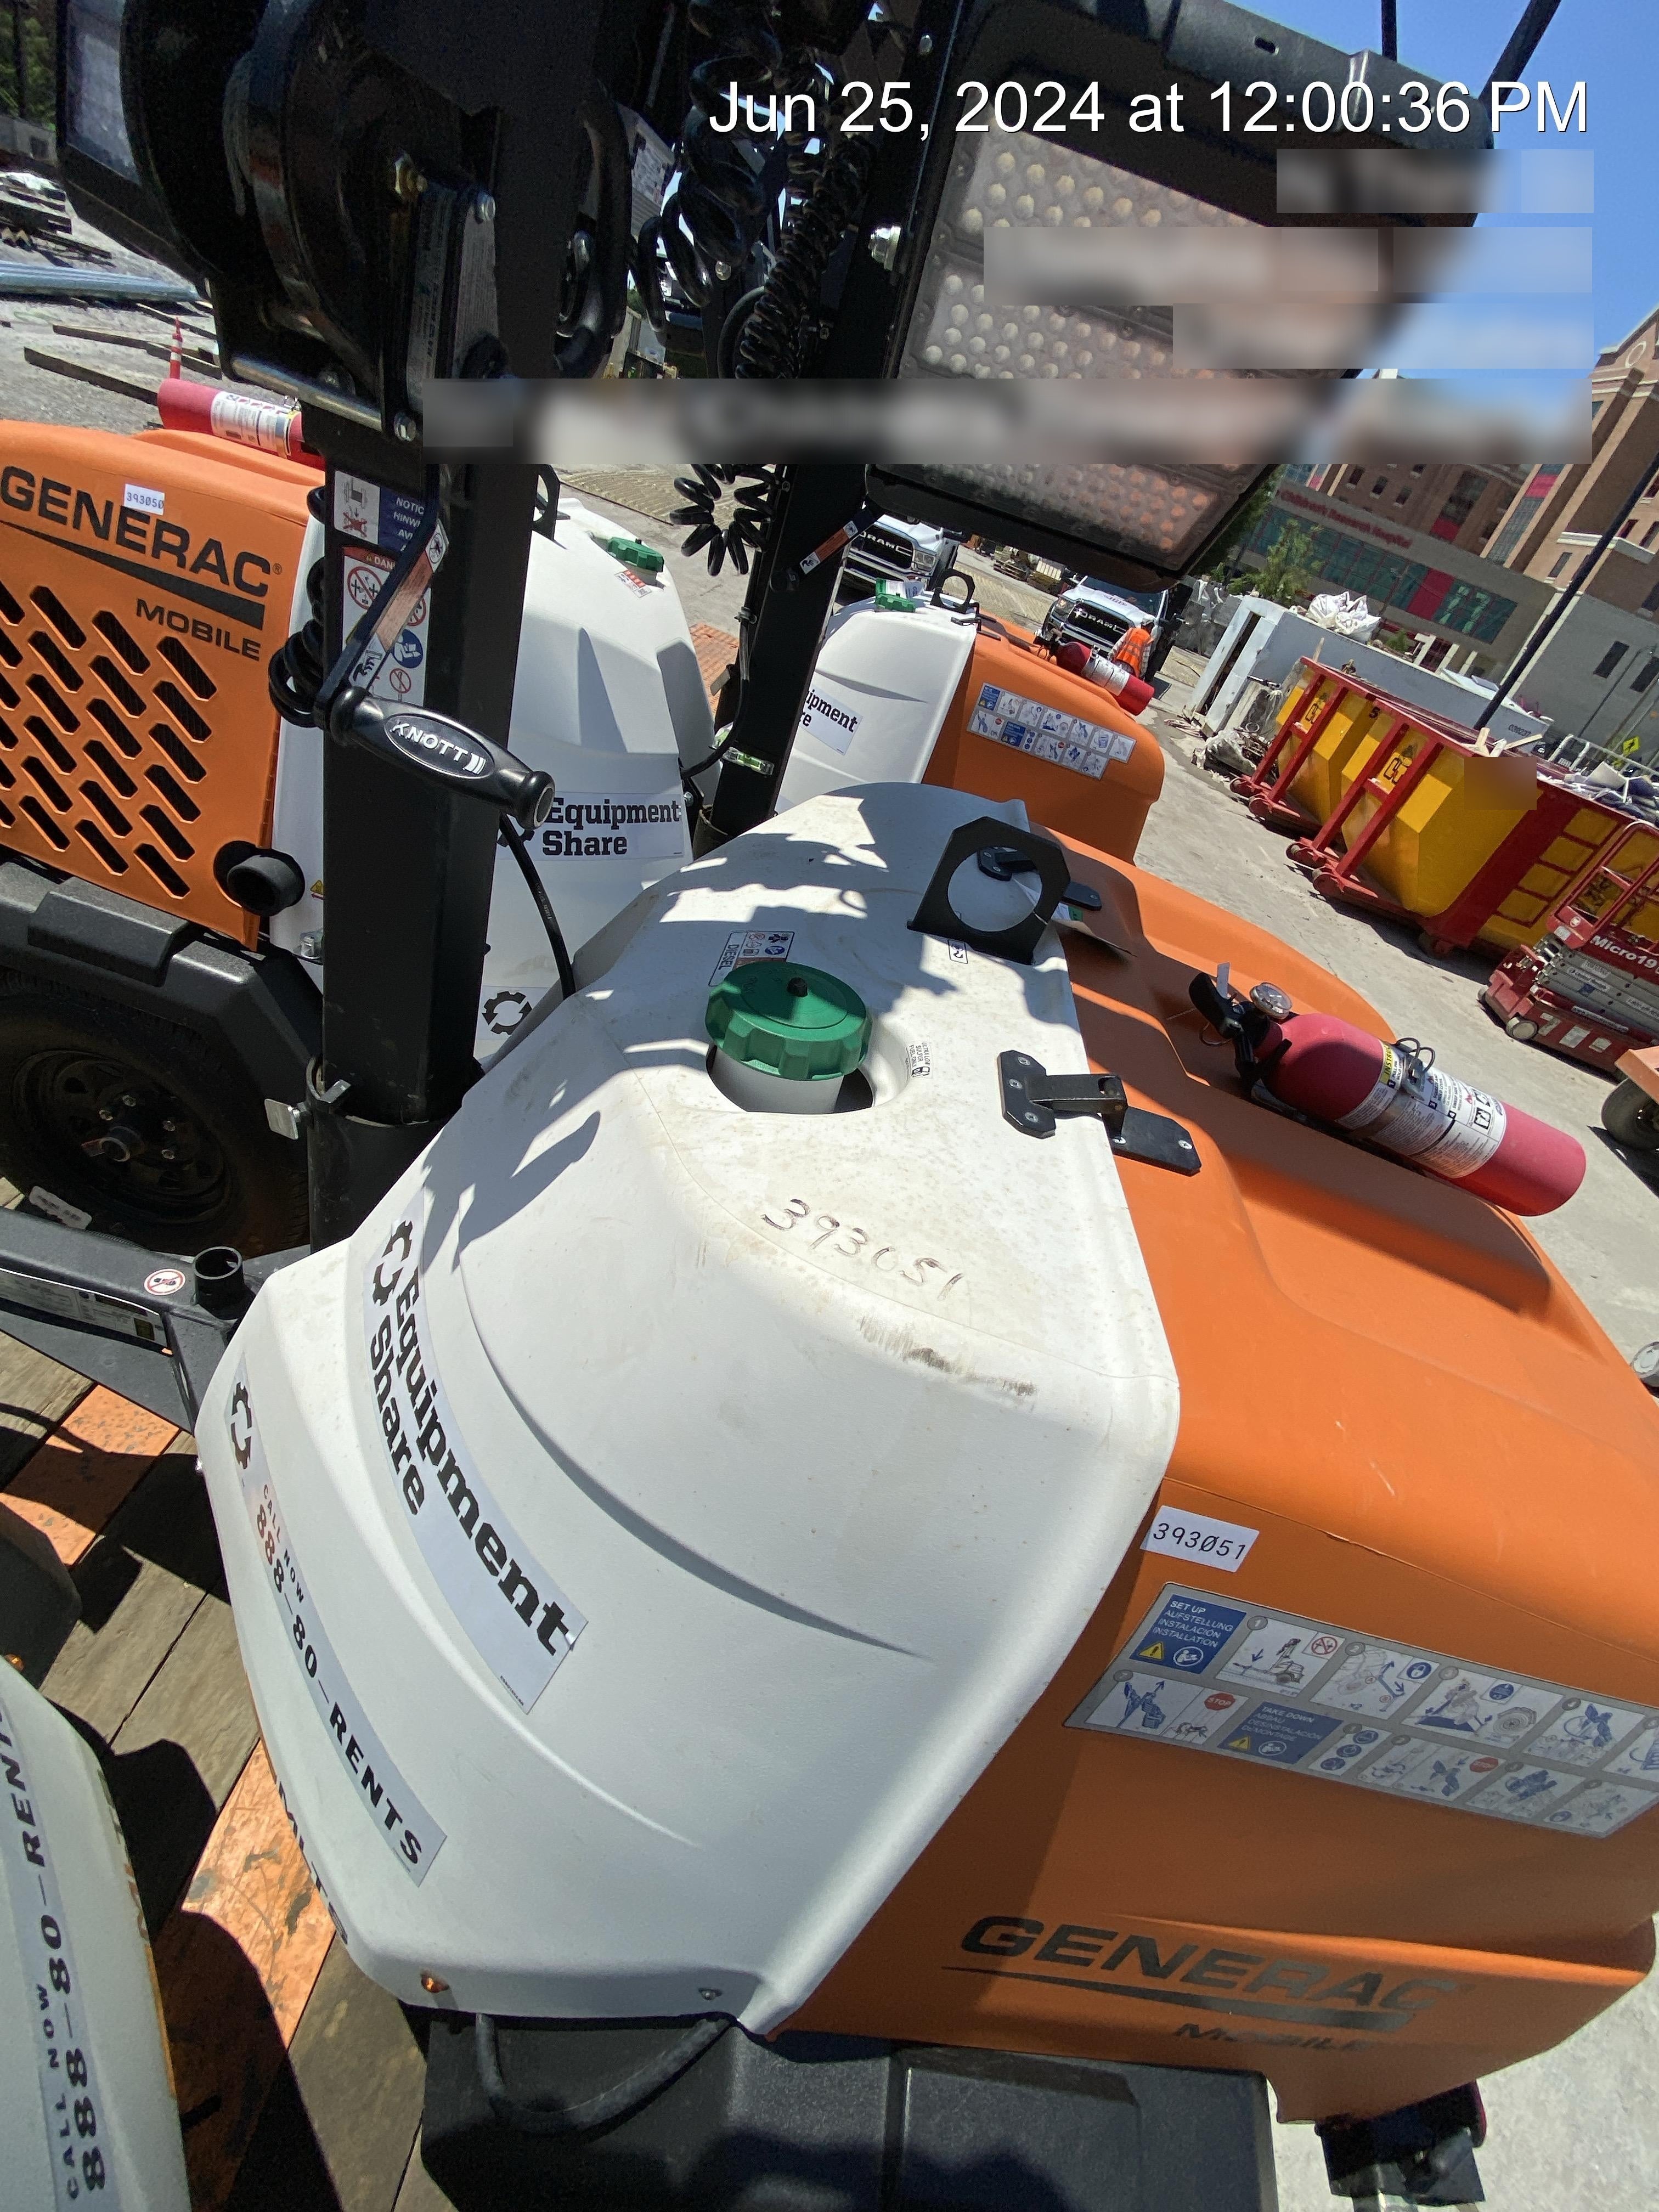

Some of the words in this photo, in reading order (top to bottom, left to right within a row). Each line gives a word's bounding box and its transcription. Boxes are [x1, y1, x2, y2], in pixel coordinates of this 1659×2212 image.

[126, 490, 165, 510] 393050
[867, 533, 895, 549] RAM
[136, 598, 261, 661] MOBILE
[1088, 615, 1113, 629] RAM
[390, 720, 470, 762] KNOTT
[542, 797, 681, 830] Equipment
[542, 830, 628, 856] Share
[1590, 935, 1657, 969] Micro19
[760, 1198, 965, 1300] 393051
[370, 1314, 425, 1515] Share
[395, 1268, 571, 1656] Equipment
[262, 1483, 281, 1544] CALL
[283, 1548, 304, 1604] NOW
[1152, 1522, 1246, 1561] 393051
[1164, 1610, 1234, 1632] AUFSTELLUNG
[1170, 1600, 1191, 1612] SET
[1192, 1605, 1206, 1614] UP
[1152, 1627, 1219, 1648] INSTALLATION
[256, 1504, 423, 1865] 888-80-RENTS
[1207, 1696, 1232, 1707] STOP
[1262, 1706, 1285, 1718] TAKE
[1286, 1711, 1315, 1723] DOWN
[961, 1915, 1458, 2012] GENERAC
[35, 1983, 60, 2069] NOW
[53, 2092, 80, 2199] CALL
